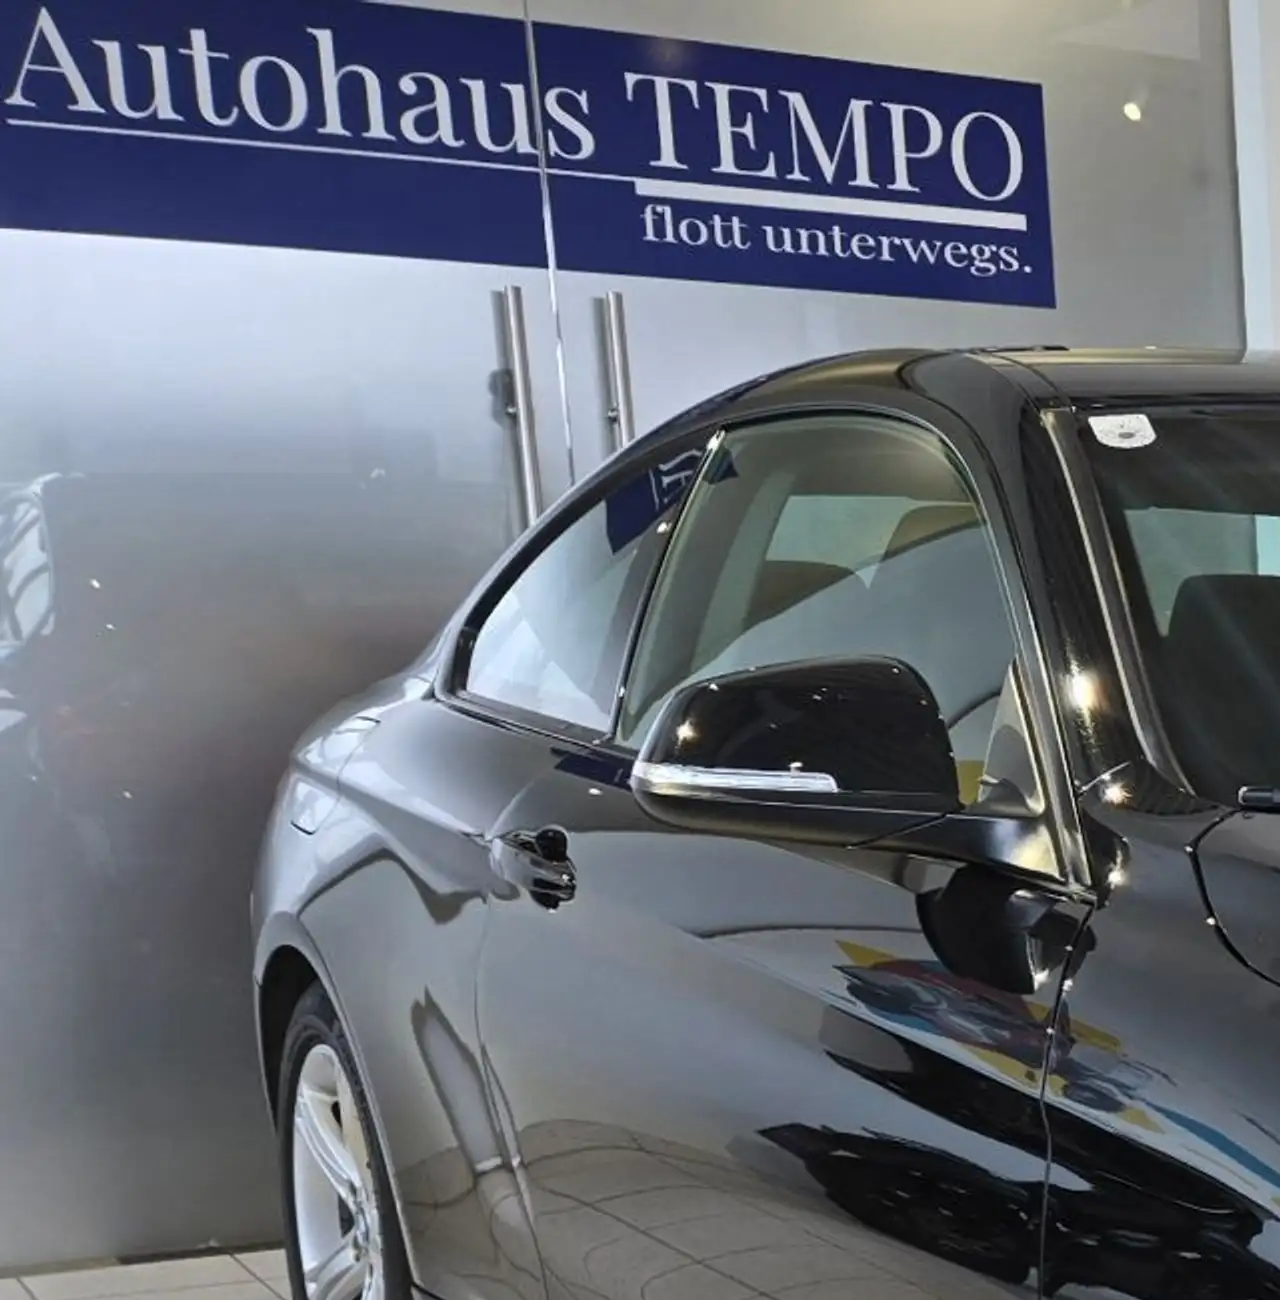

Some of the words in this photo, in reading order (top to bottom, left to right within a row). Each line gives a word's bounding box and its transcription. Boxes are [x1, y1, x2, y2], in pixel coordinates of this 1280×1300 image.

[5, 6, 595, 161] Autohaus
[624, 70, 1024, 201] TEMPO
[641, 202, 751, 251] flott
[761, 222, 1033, 277] unterwegs.
